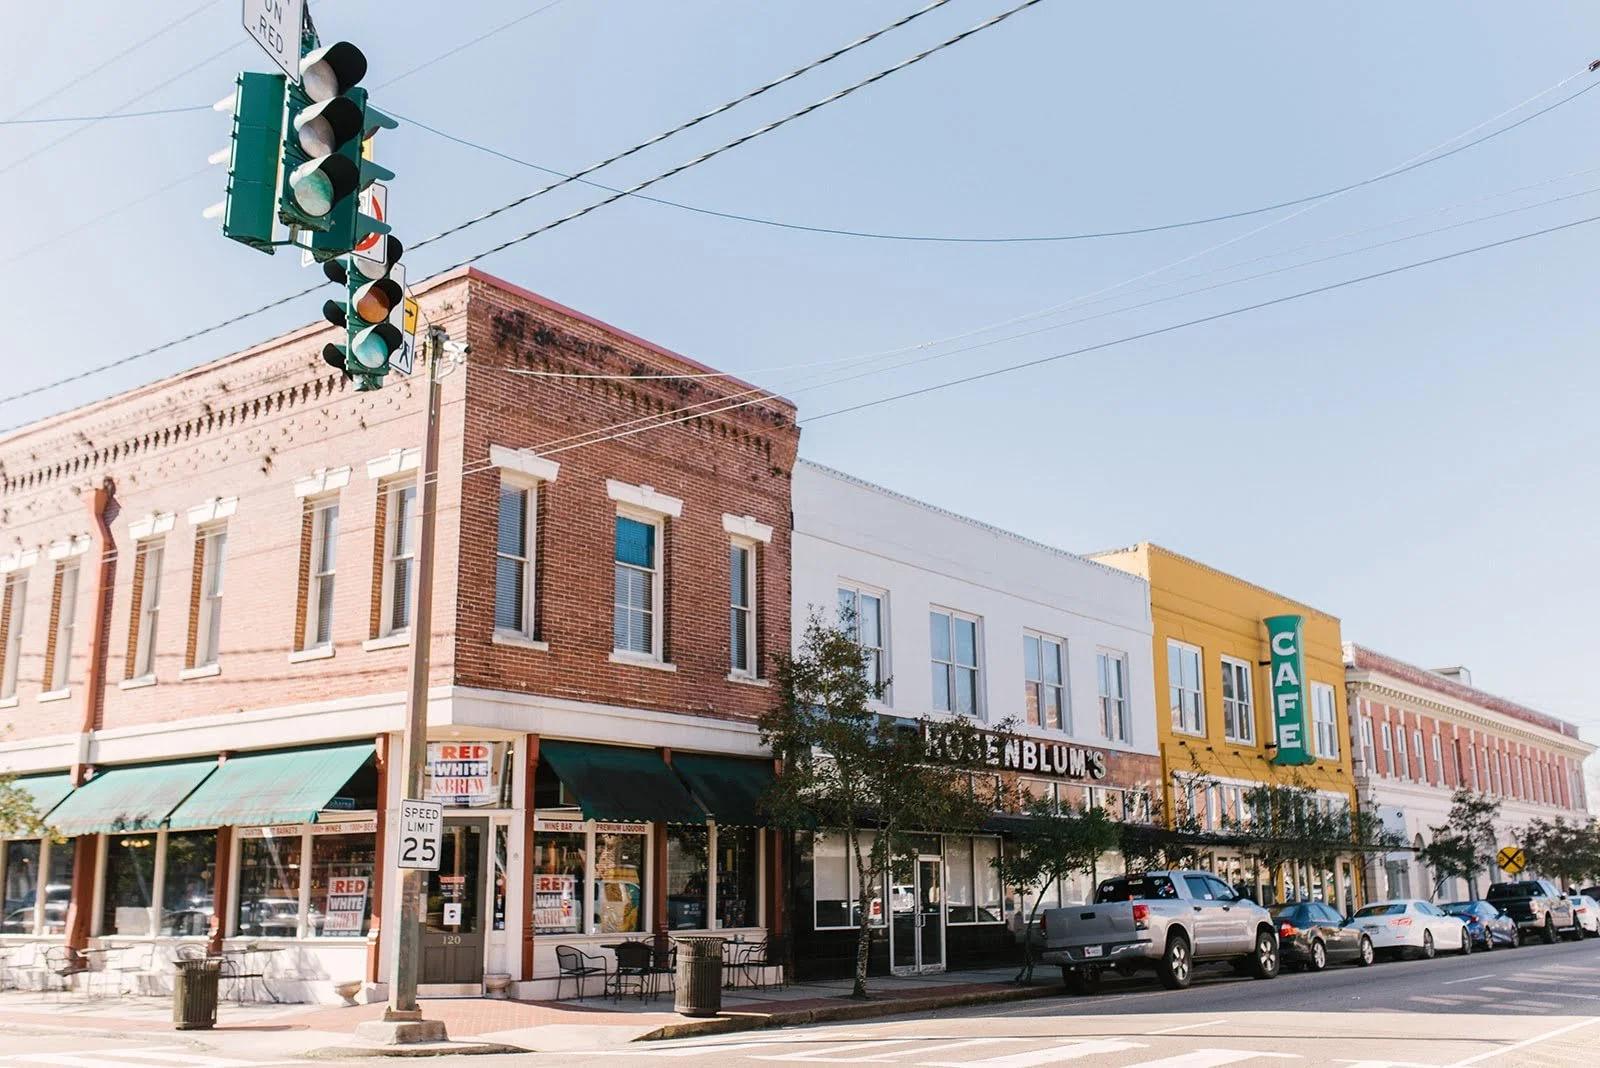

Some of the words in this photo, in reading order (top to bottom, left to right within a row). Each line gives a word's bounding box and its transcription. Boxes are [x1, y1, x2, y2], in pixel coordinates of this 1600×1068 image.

[260, 15, 283, 54] RED
[1272, 632, 1301, 749] CAFE
[442, 746, 489, 759] RED
[435, 762, 488, 776] WHITE
[405, 807, 439, 820] SPEED
[407, 822, 435, 833] LIMIT
[544, 822, 560, 831] WINE
[560, 822, 573, 831] BAR
[596, 823, 621, 832] PREMIUM
[402, 837, 436, 861] 25
[336, 880, 366, 893] RED
[330, 897, 364, 910] WHITE
[443, 935, 461, 945] 120
